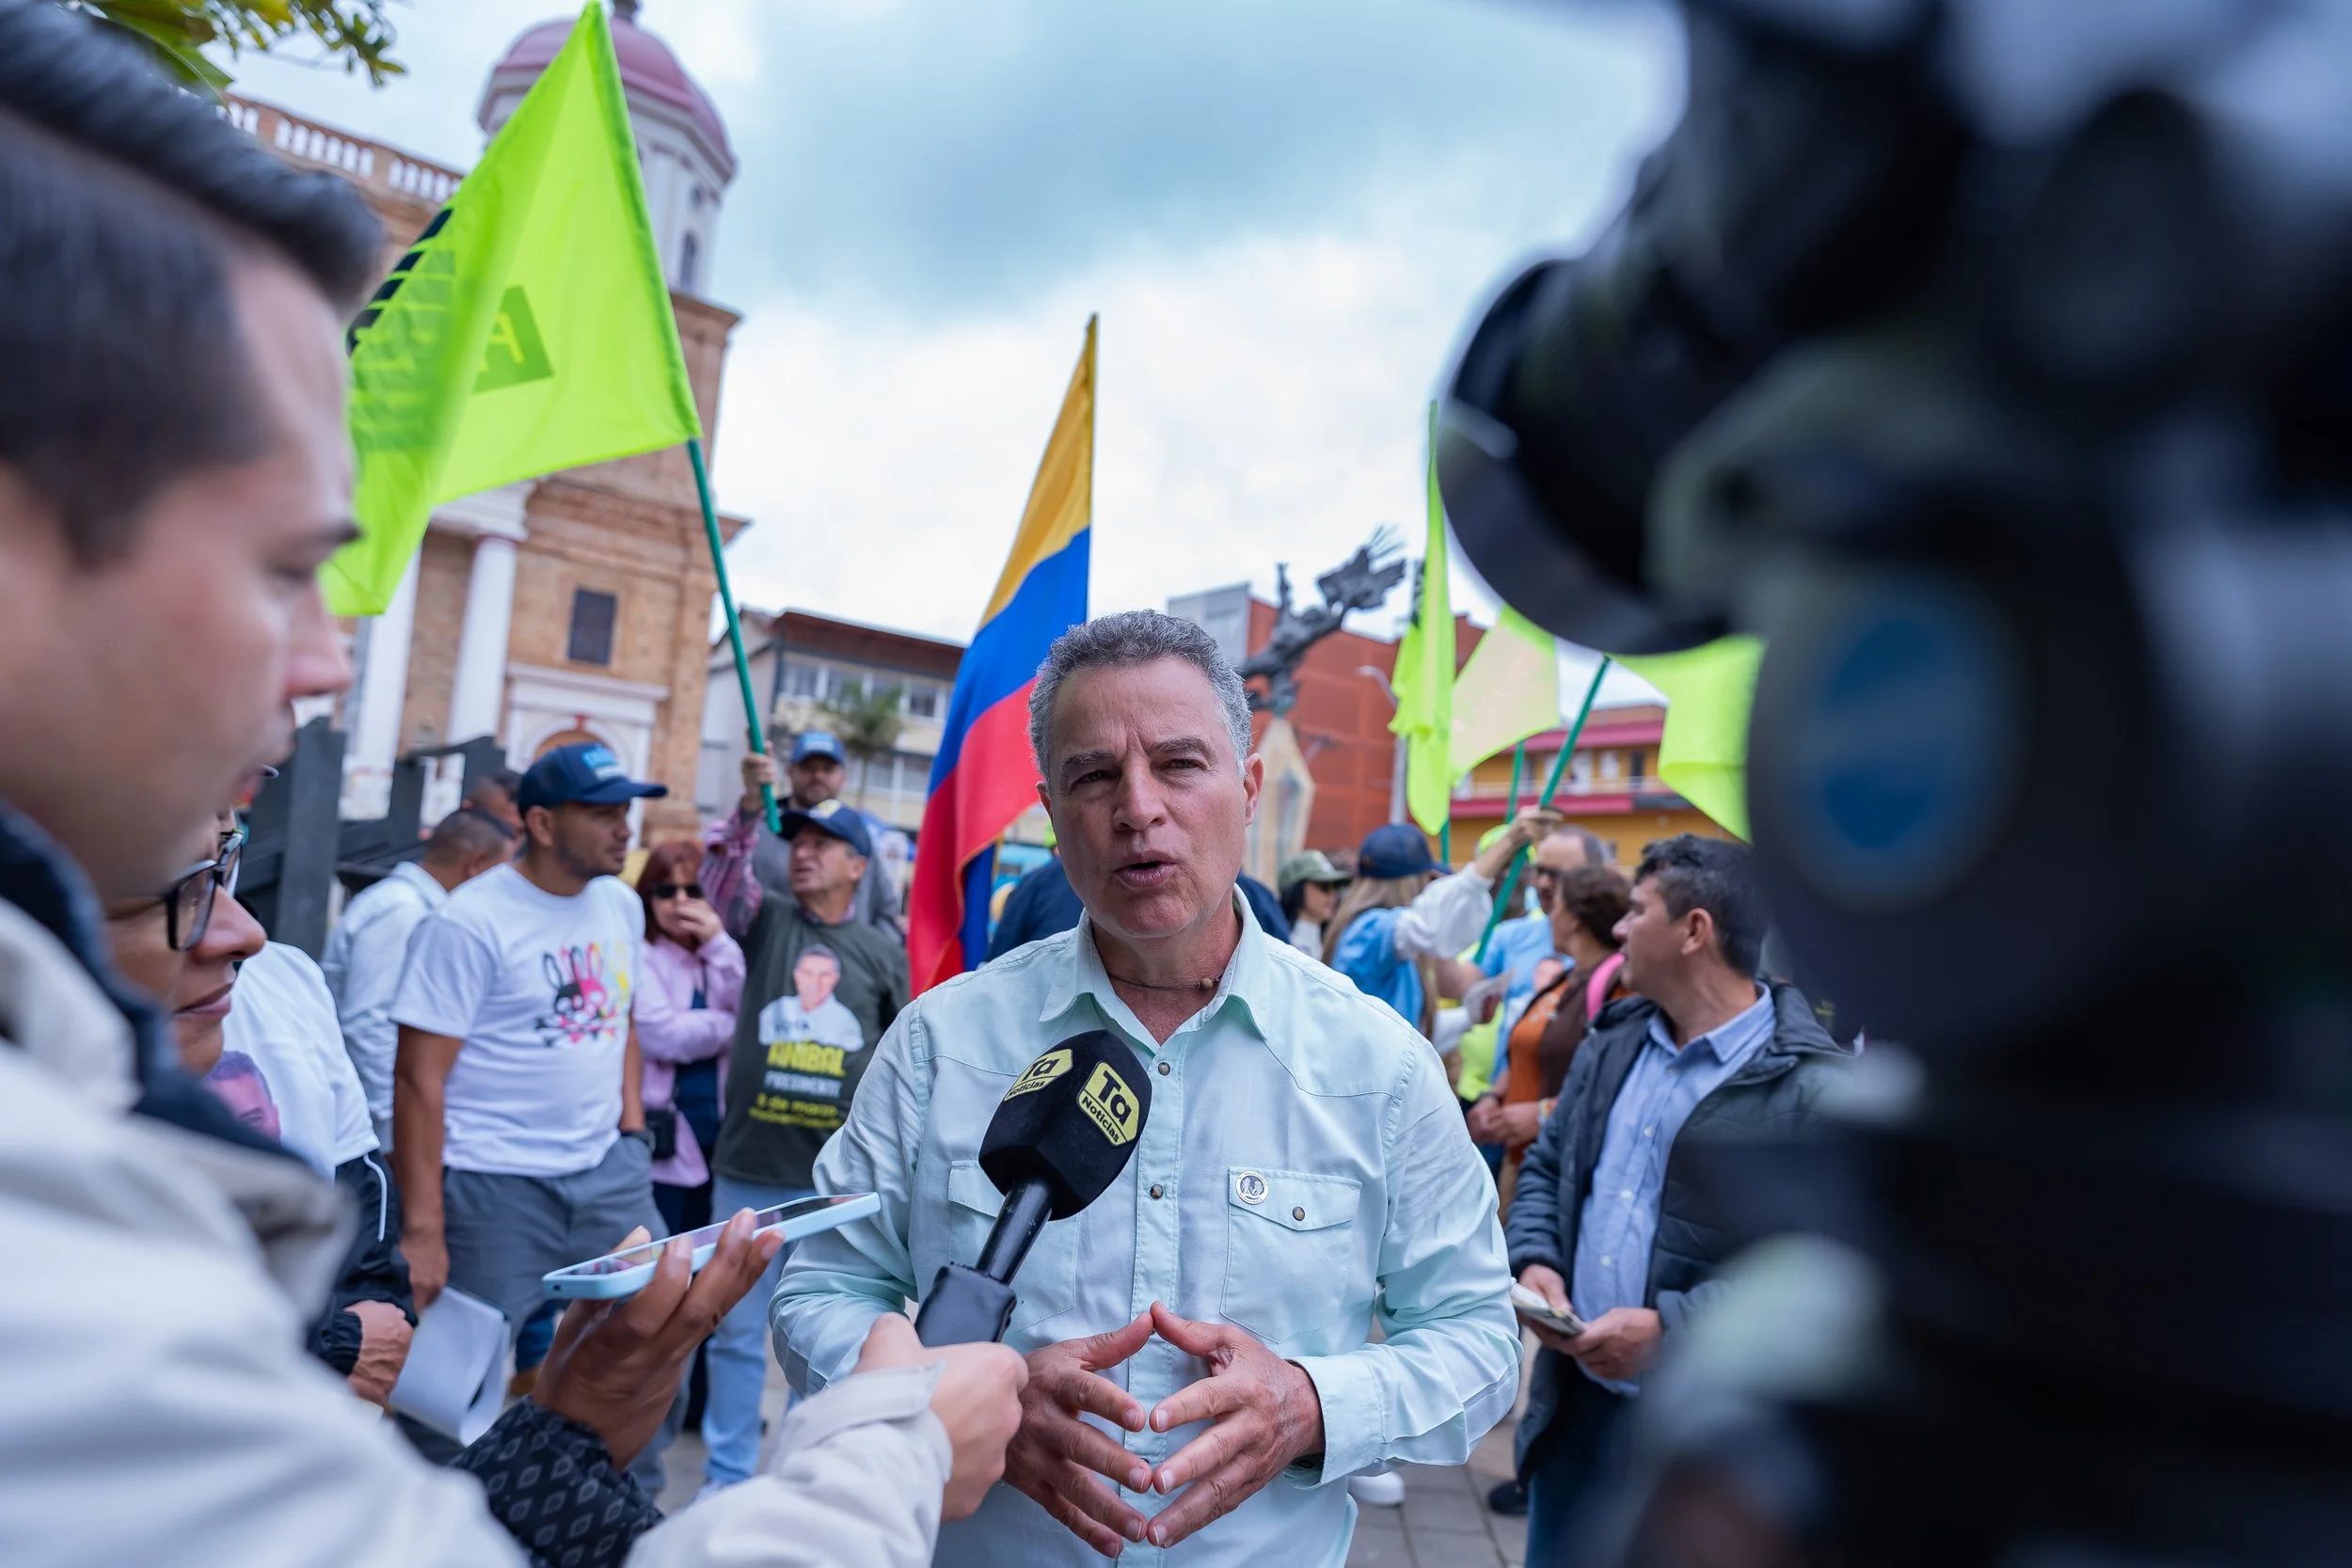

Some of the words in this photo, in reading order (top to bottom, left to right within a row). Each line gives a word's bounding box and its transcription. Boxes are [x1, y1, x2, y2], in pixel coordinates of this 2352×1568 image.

[1022, 1057, 1060, 1082] Ta
[1006, 1081, 1045, 1100] Noticias
[1098, 1069, 1132, 1127] Ta
[1082, 1096, 1120, 1143] Noticias
